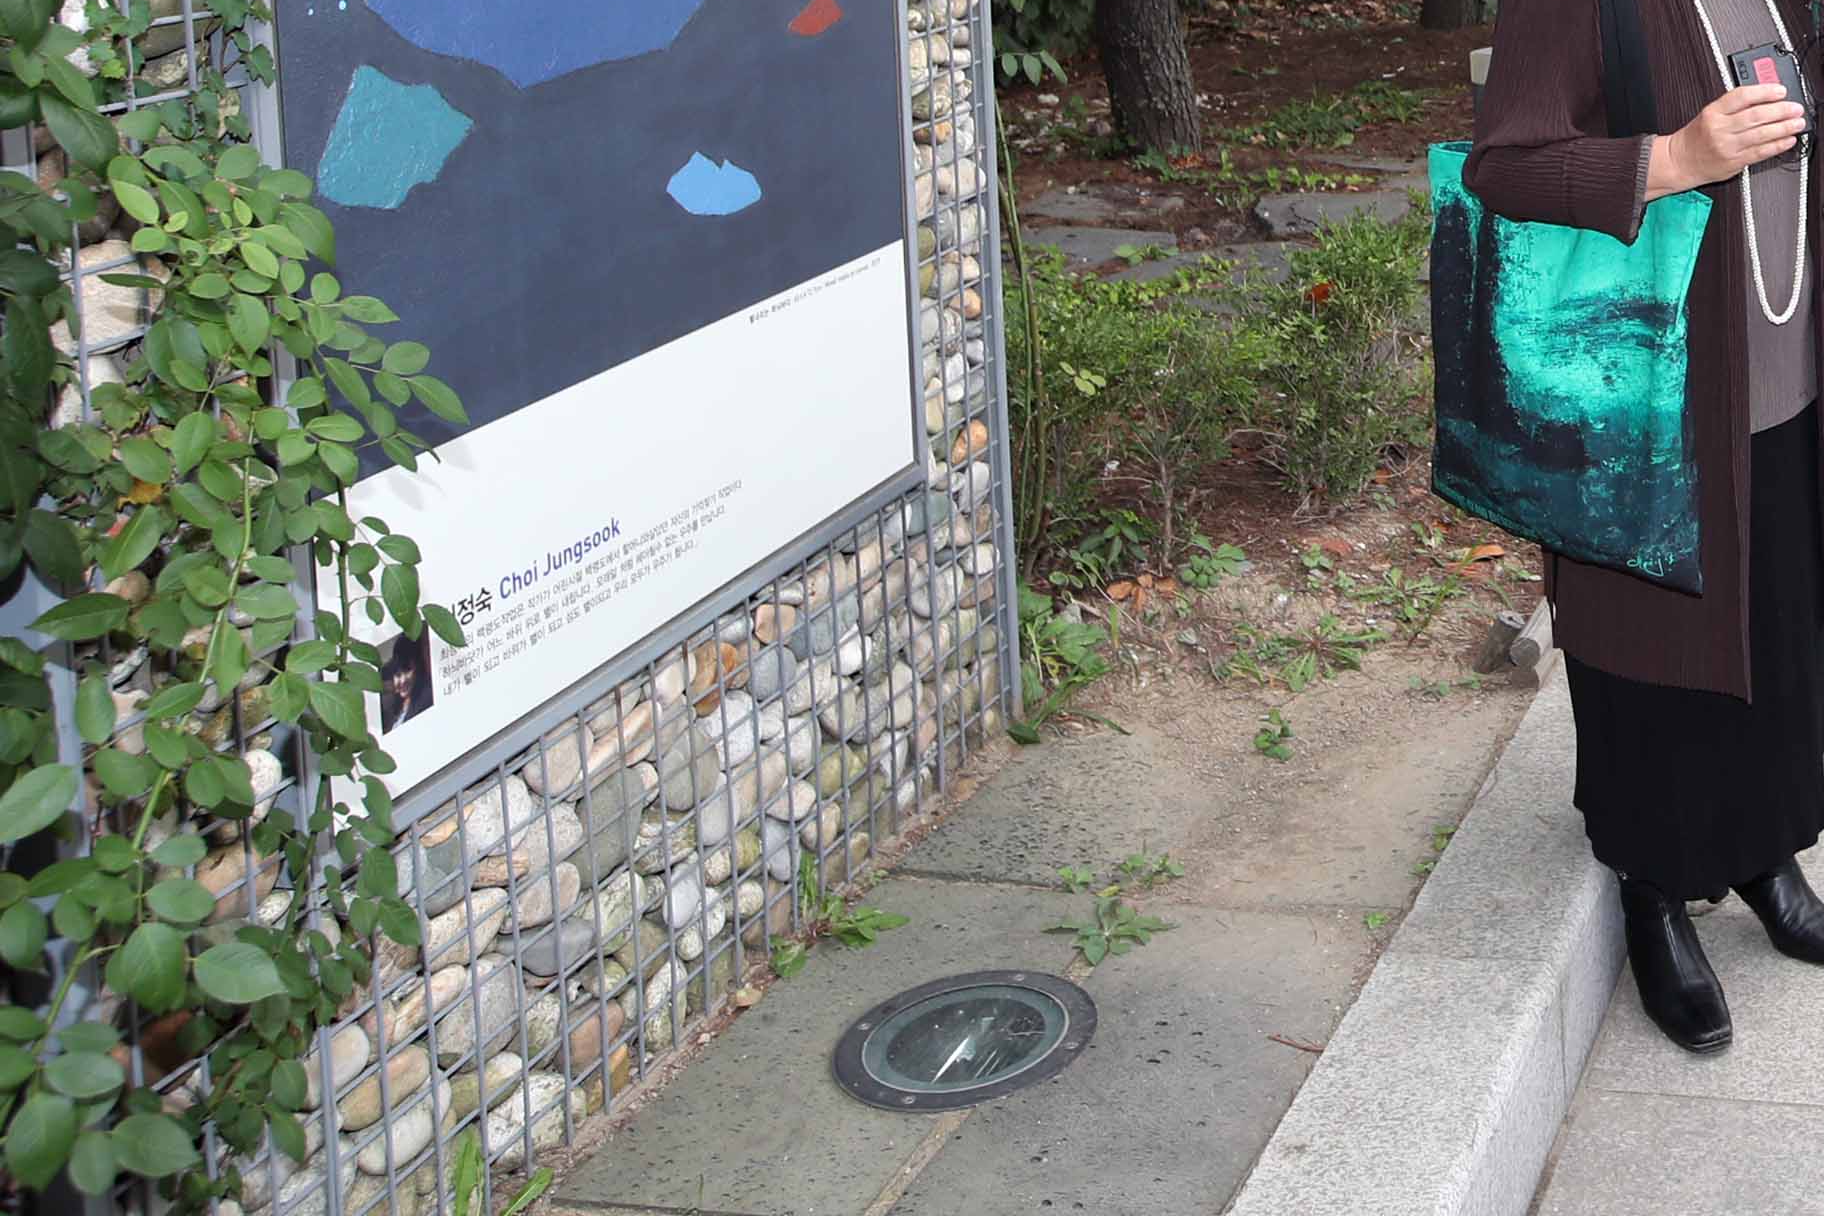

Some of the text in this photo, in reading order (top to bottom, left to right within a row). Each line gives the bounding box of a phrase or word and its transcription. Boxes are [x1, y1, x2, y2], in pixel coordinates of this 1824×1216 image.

[451, 517, 621, 626] 정숙 Choi Jungsook
